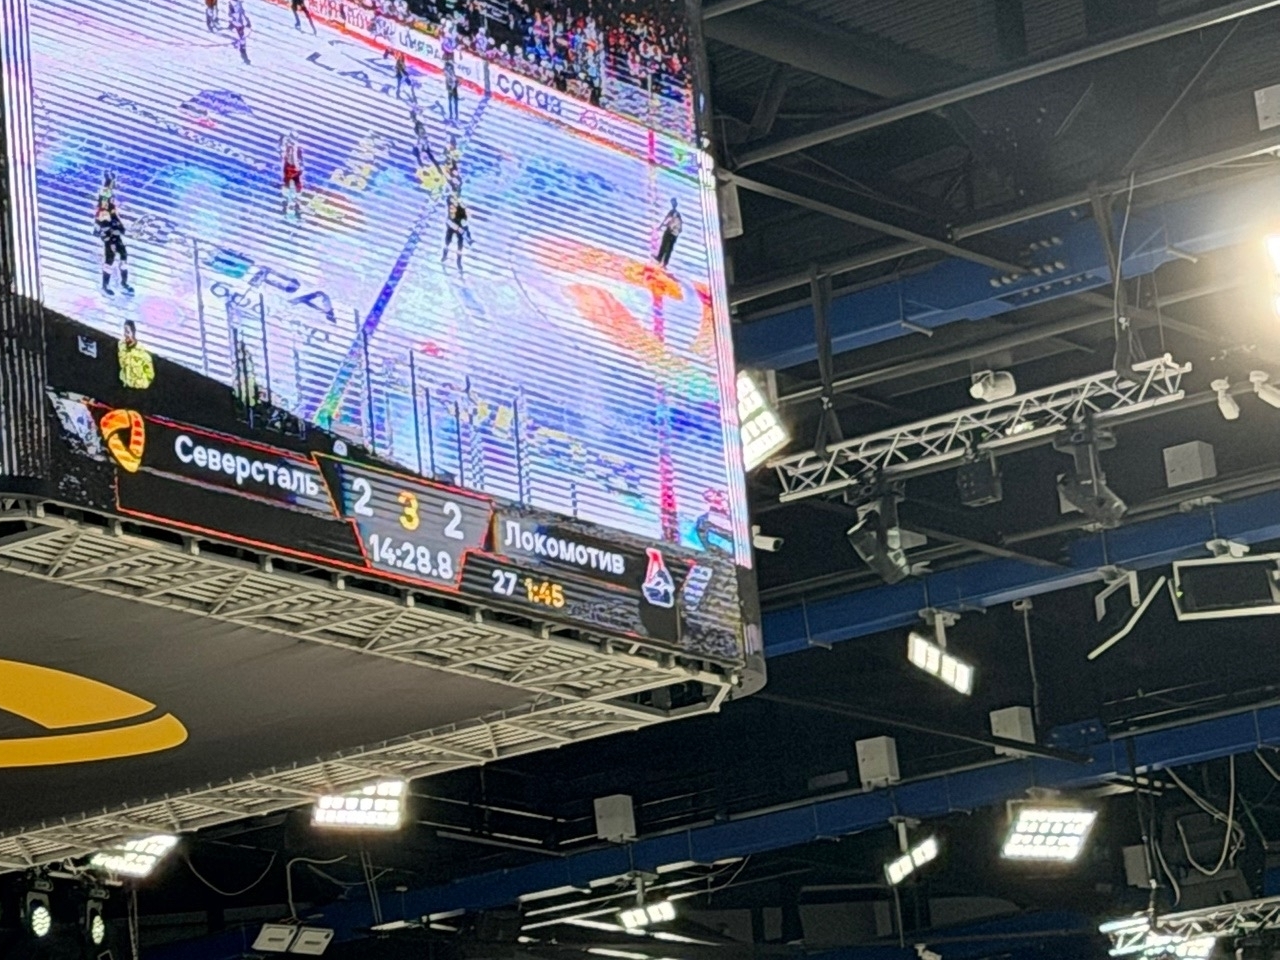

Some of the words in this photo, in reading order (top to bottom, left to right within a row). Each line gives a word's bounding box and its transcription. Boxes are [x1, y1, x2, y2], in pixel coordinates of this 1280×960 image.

[174, 434, 319, 496] Северсталь
[352, 477, 374, 517] 2
[397, 490, 420, 531] 3
[443, 501, 464, 540] 2
[369, 534, 454, 580] 14:28.8
[504, 520, 626, 575] Локомотив
[492, 569, 518, 596] 27
[524, 577, 566, 609] 1:45
